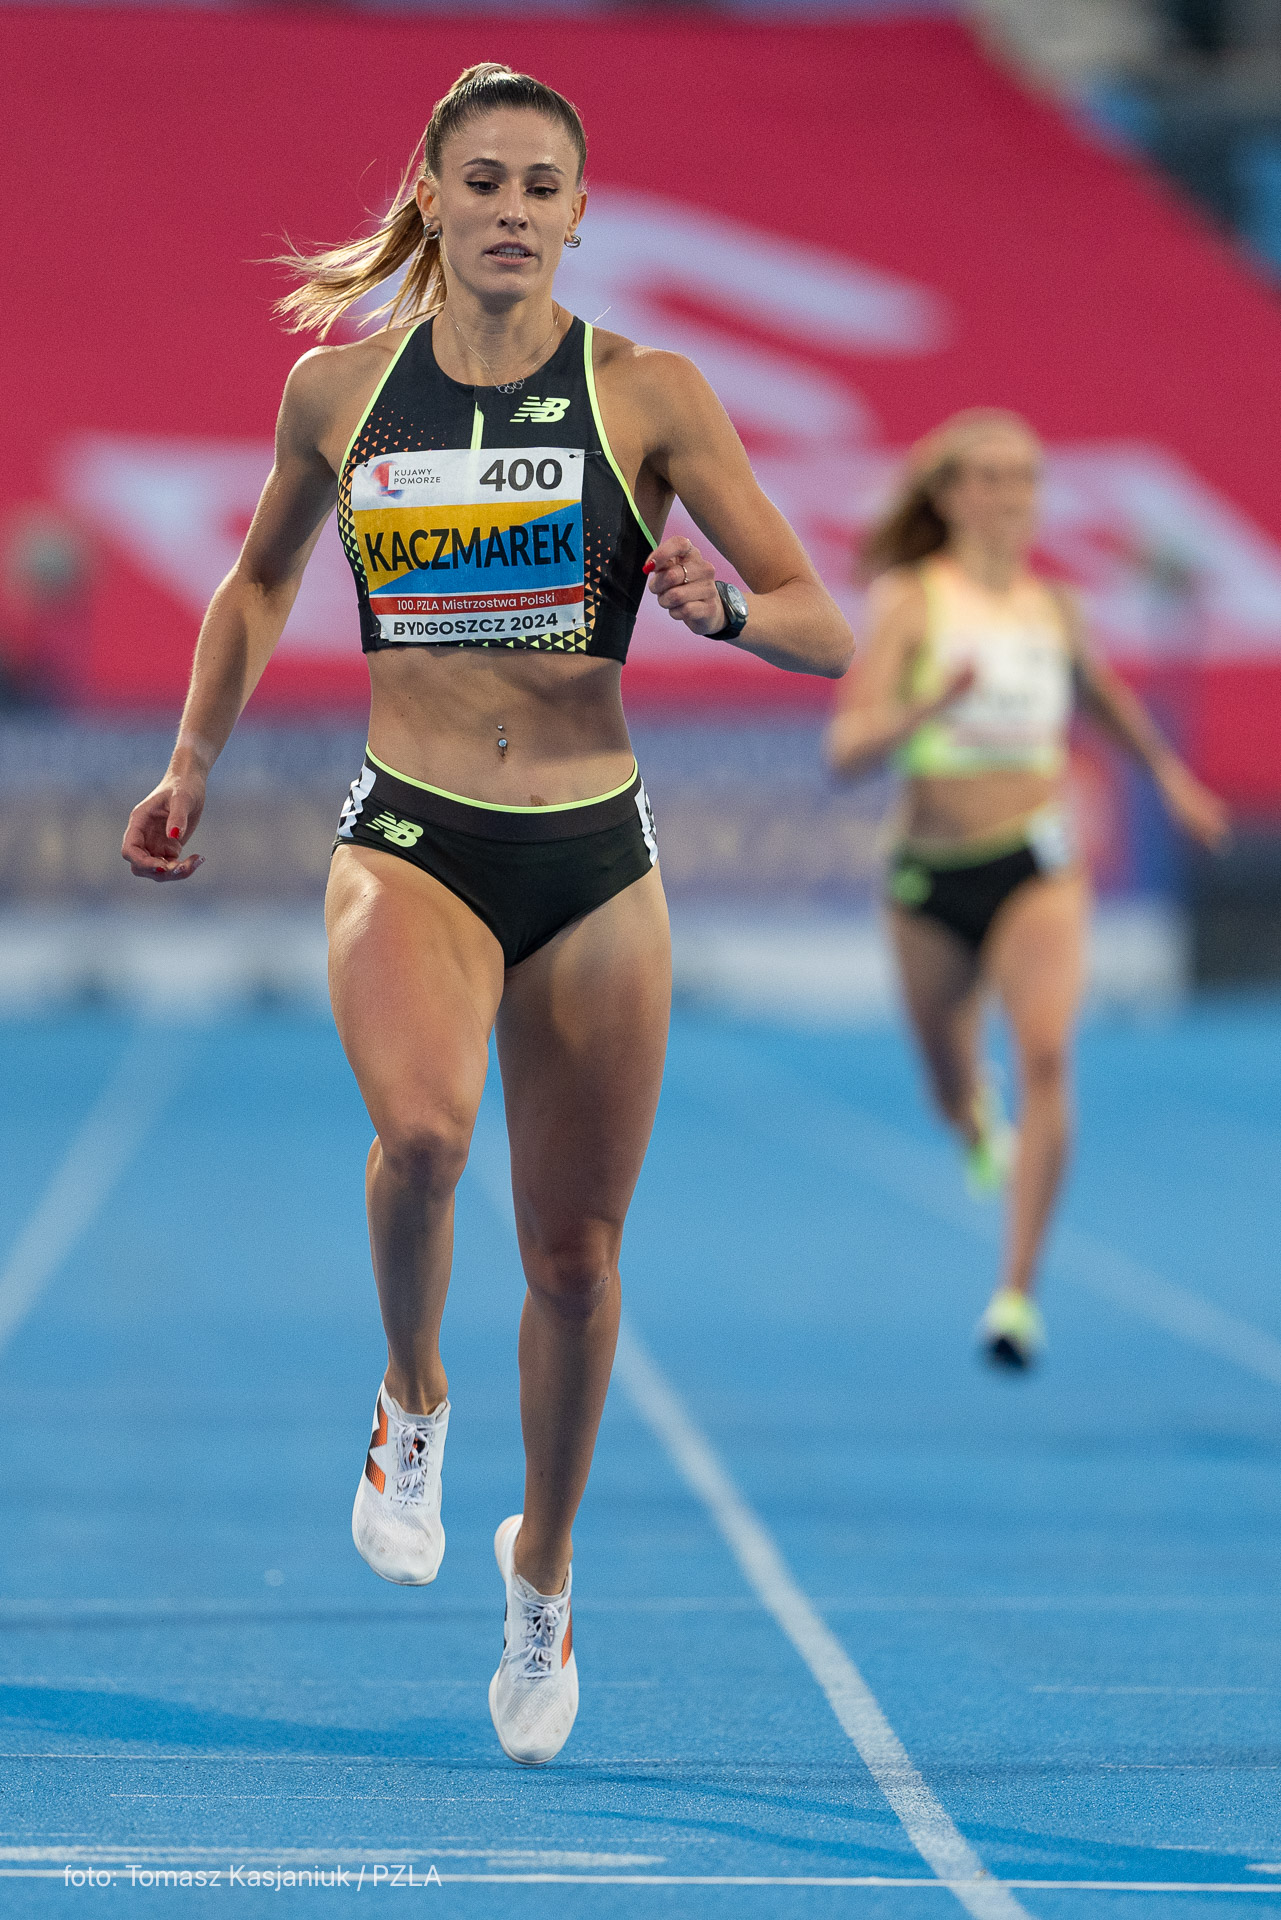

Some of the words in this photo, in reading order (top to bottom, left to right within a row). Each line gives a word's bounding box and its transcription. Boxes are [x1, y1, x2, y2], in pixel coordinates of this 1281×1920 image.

[393, 476, 441, 485] POMORZE
[394, 468, 433, 477] KUJAWY
[479, 458, 563, 492] 400
[364, 522, 577, 573] KACZMAREK
[442, 597, 517, 610] Mistrzostwa
[520, 593, 555, 605] Polski
[393, 619, 505, 636] BYDGOSZCZ
[510, 612, 558, 631] 2024
